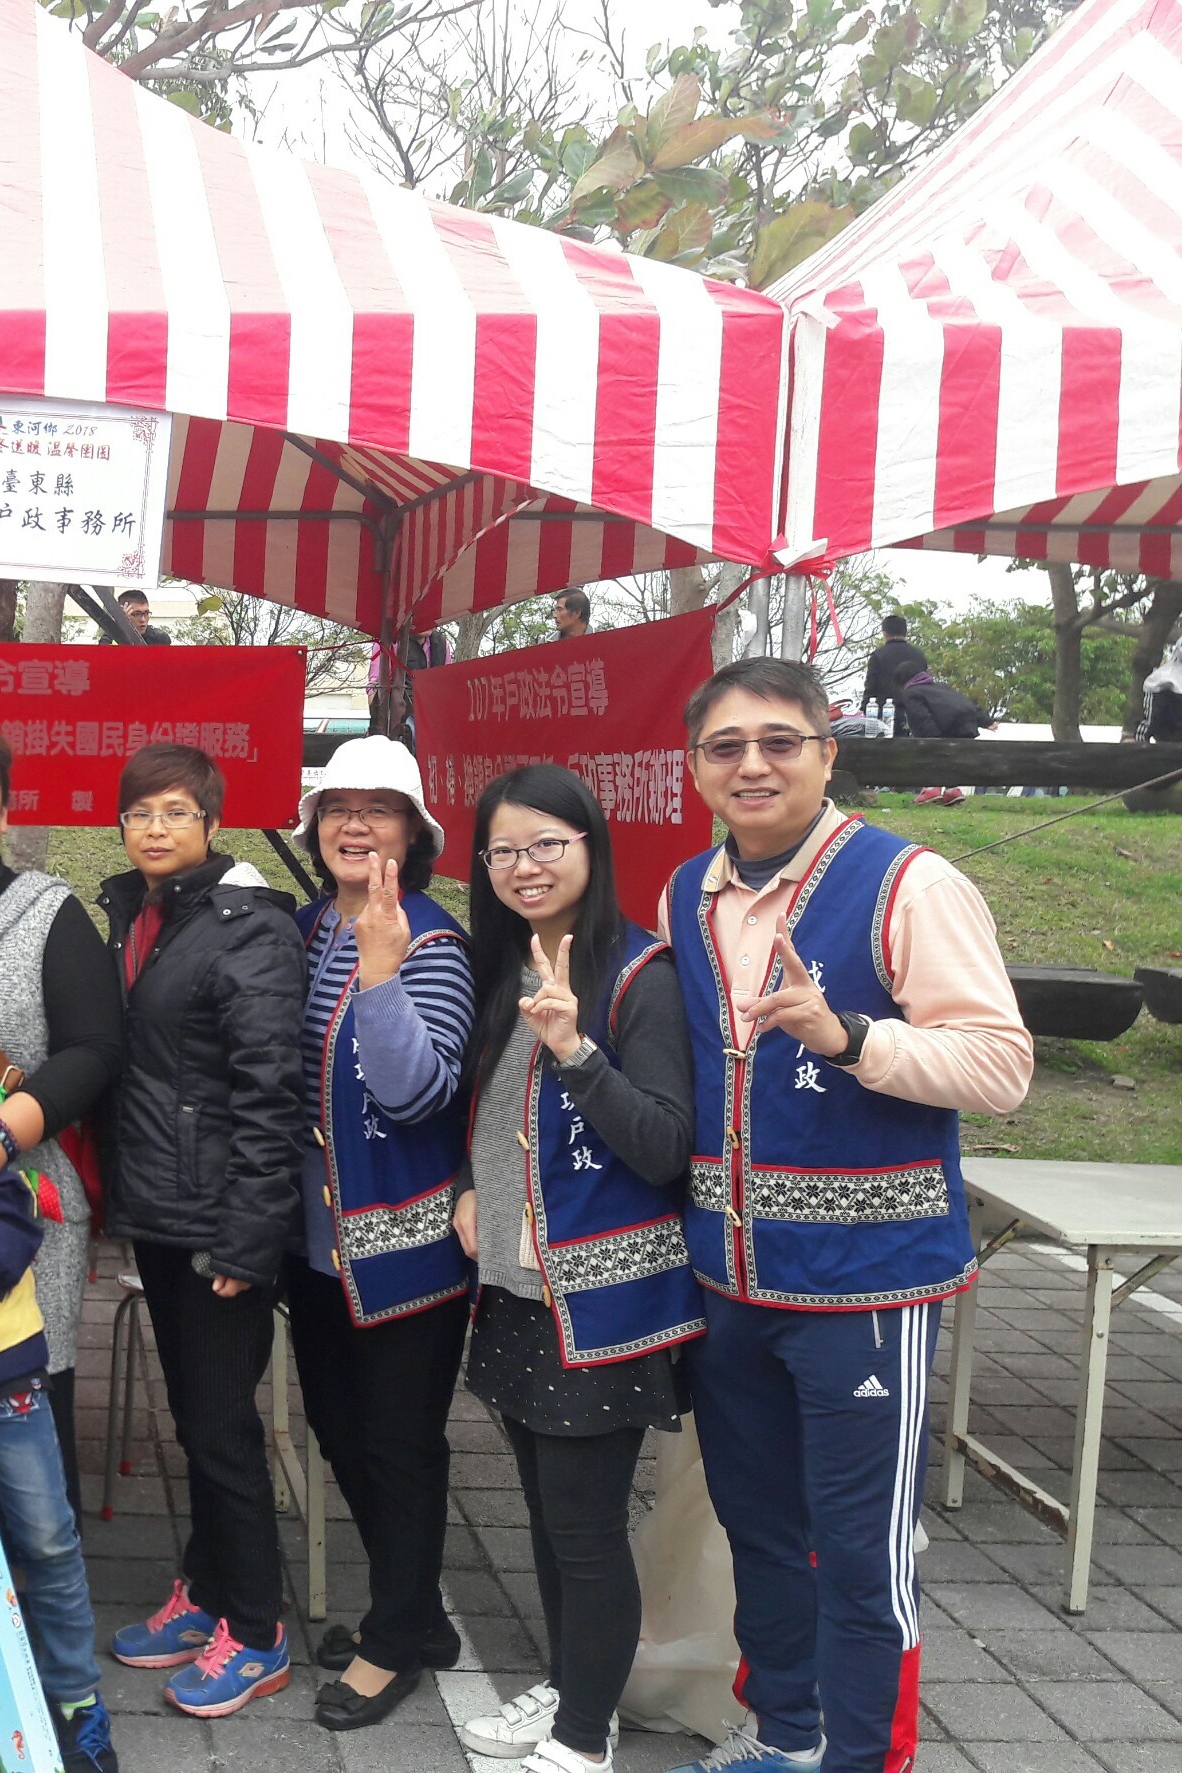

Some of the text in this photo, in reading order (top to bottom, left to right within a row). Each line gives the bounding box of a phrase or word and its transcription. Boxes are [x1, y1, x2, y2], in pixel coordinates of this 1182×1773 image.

[11, 420, 98, 437] 東河鄉 2018
[1, 469, 74, 496] 臺東縣
[853, 1388, 890, 1398] adidas
